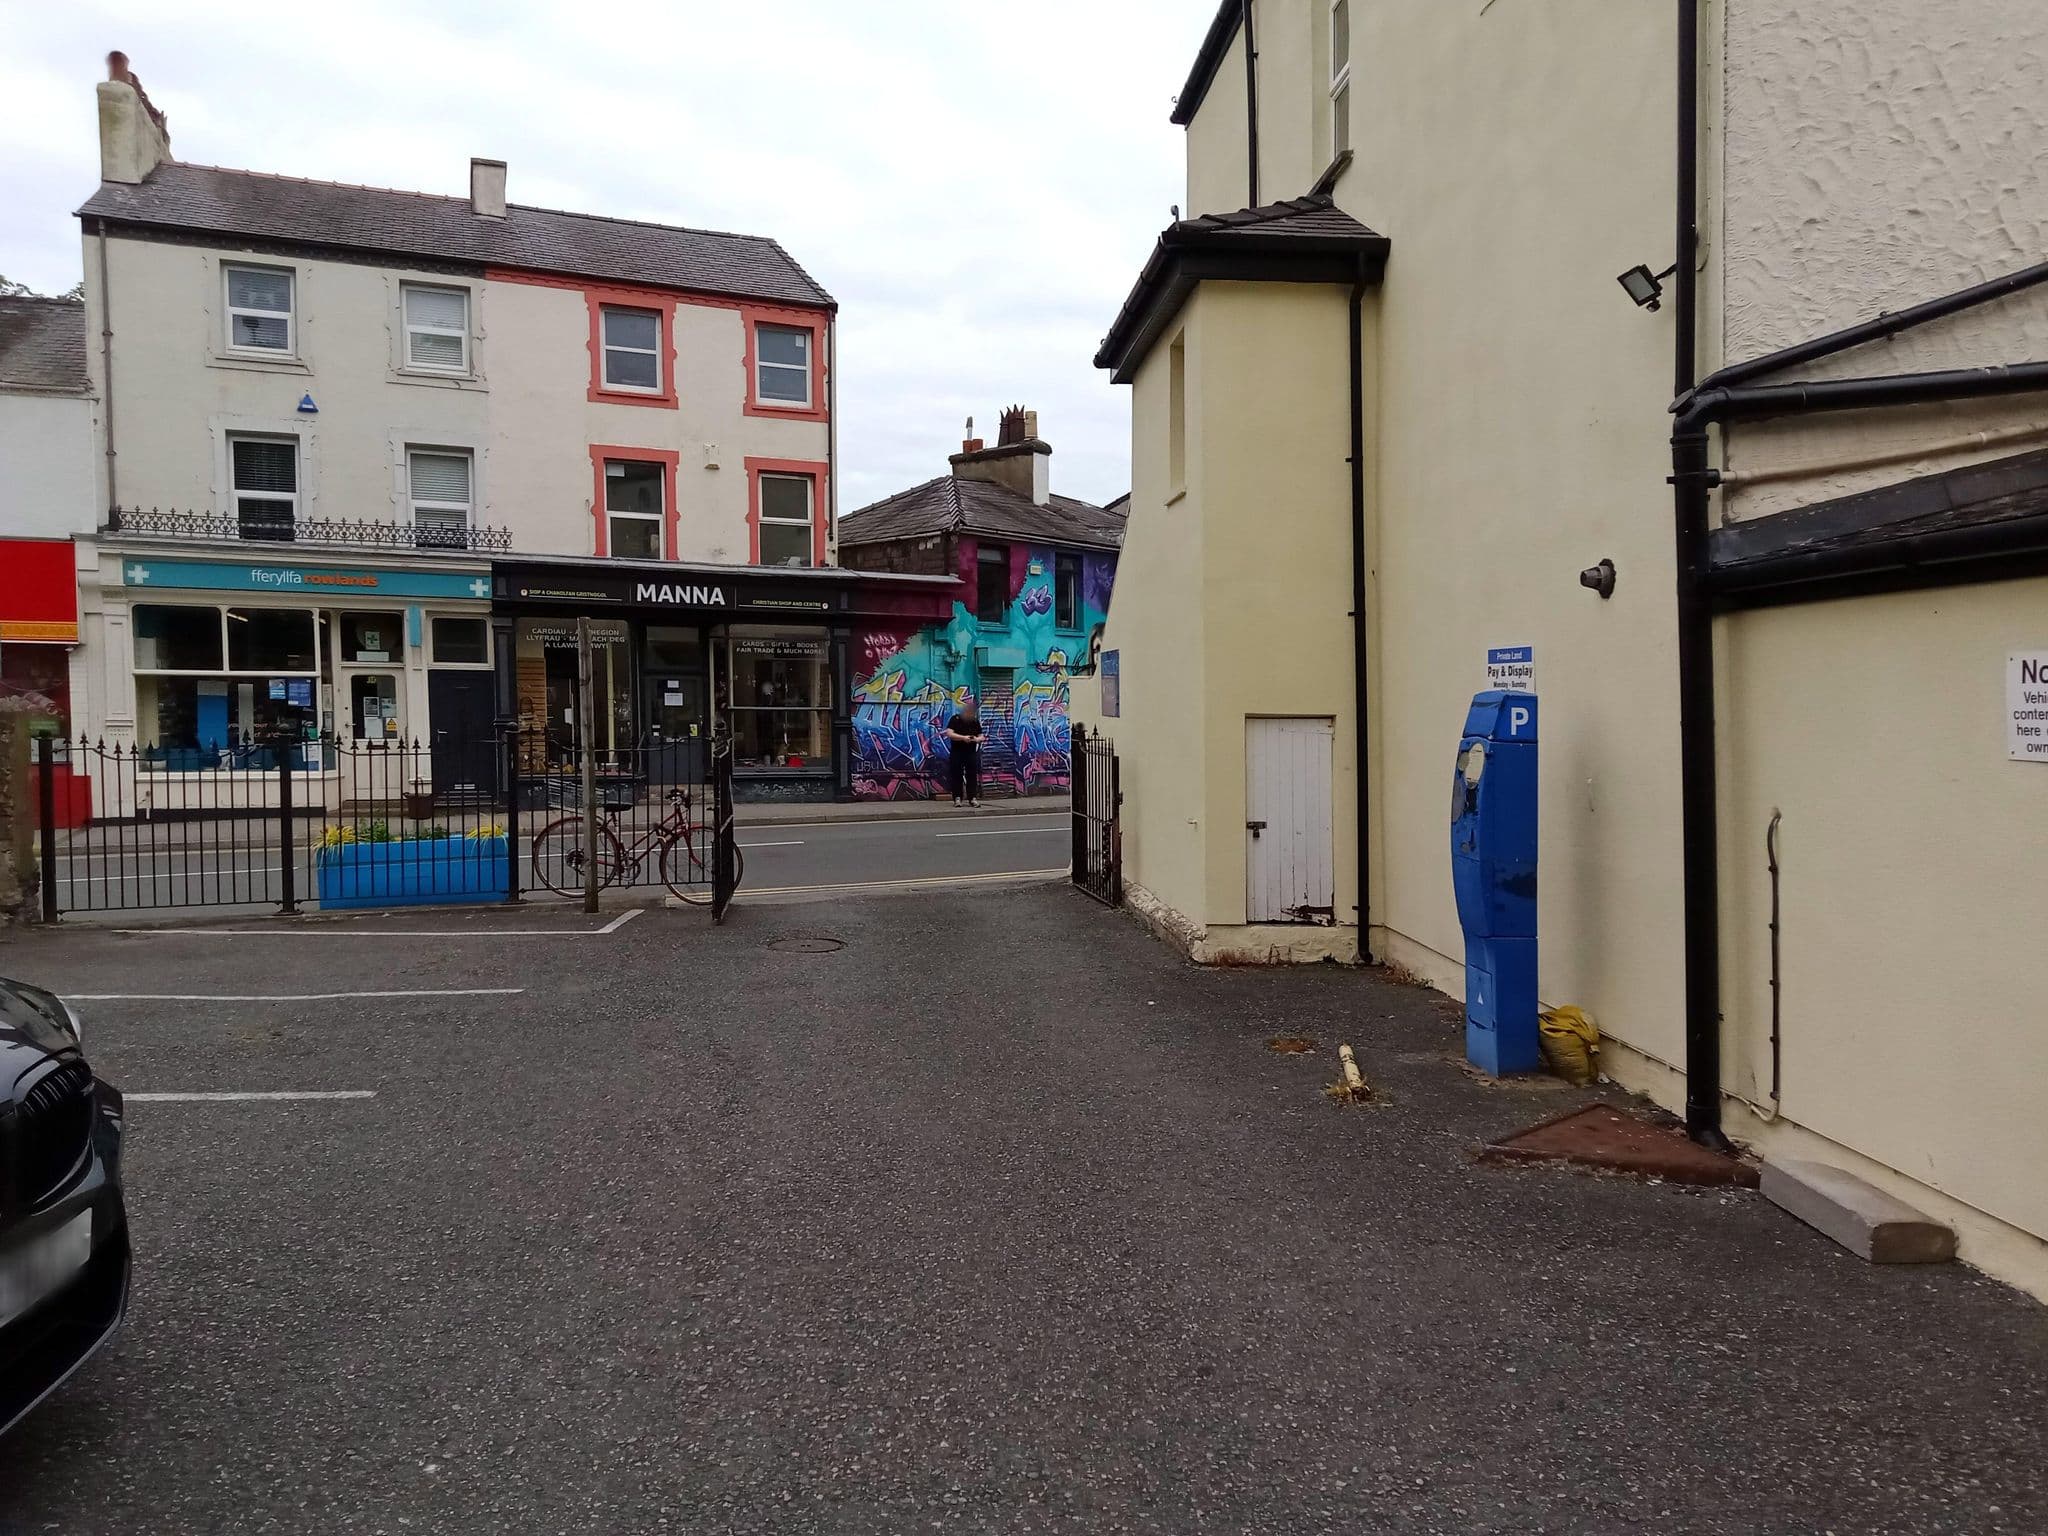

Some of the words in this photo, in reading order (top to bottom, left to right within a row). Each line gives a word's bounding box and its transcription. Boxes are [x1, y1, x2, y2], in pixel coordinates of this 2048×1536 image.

[251, 569, 301, 586] fferyllfa
[303, 573, 379, 588] rowlands
[636, 583, 726, 606] MANNA
[532, 627, 567, 635] CARDIAU
[569, 635, 607, 643] MAACH
[1487, 666, 1500, 679] Pay
[1500, 665, 1506, 677] &
[1507, 664, 1533, 679] Display
[1510, 706, 1529, 736] P
[2016, 724, 2041, 736] here
